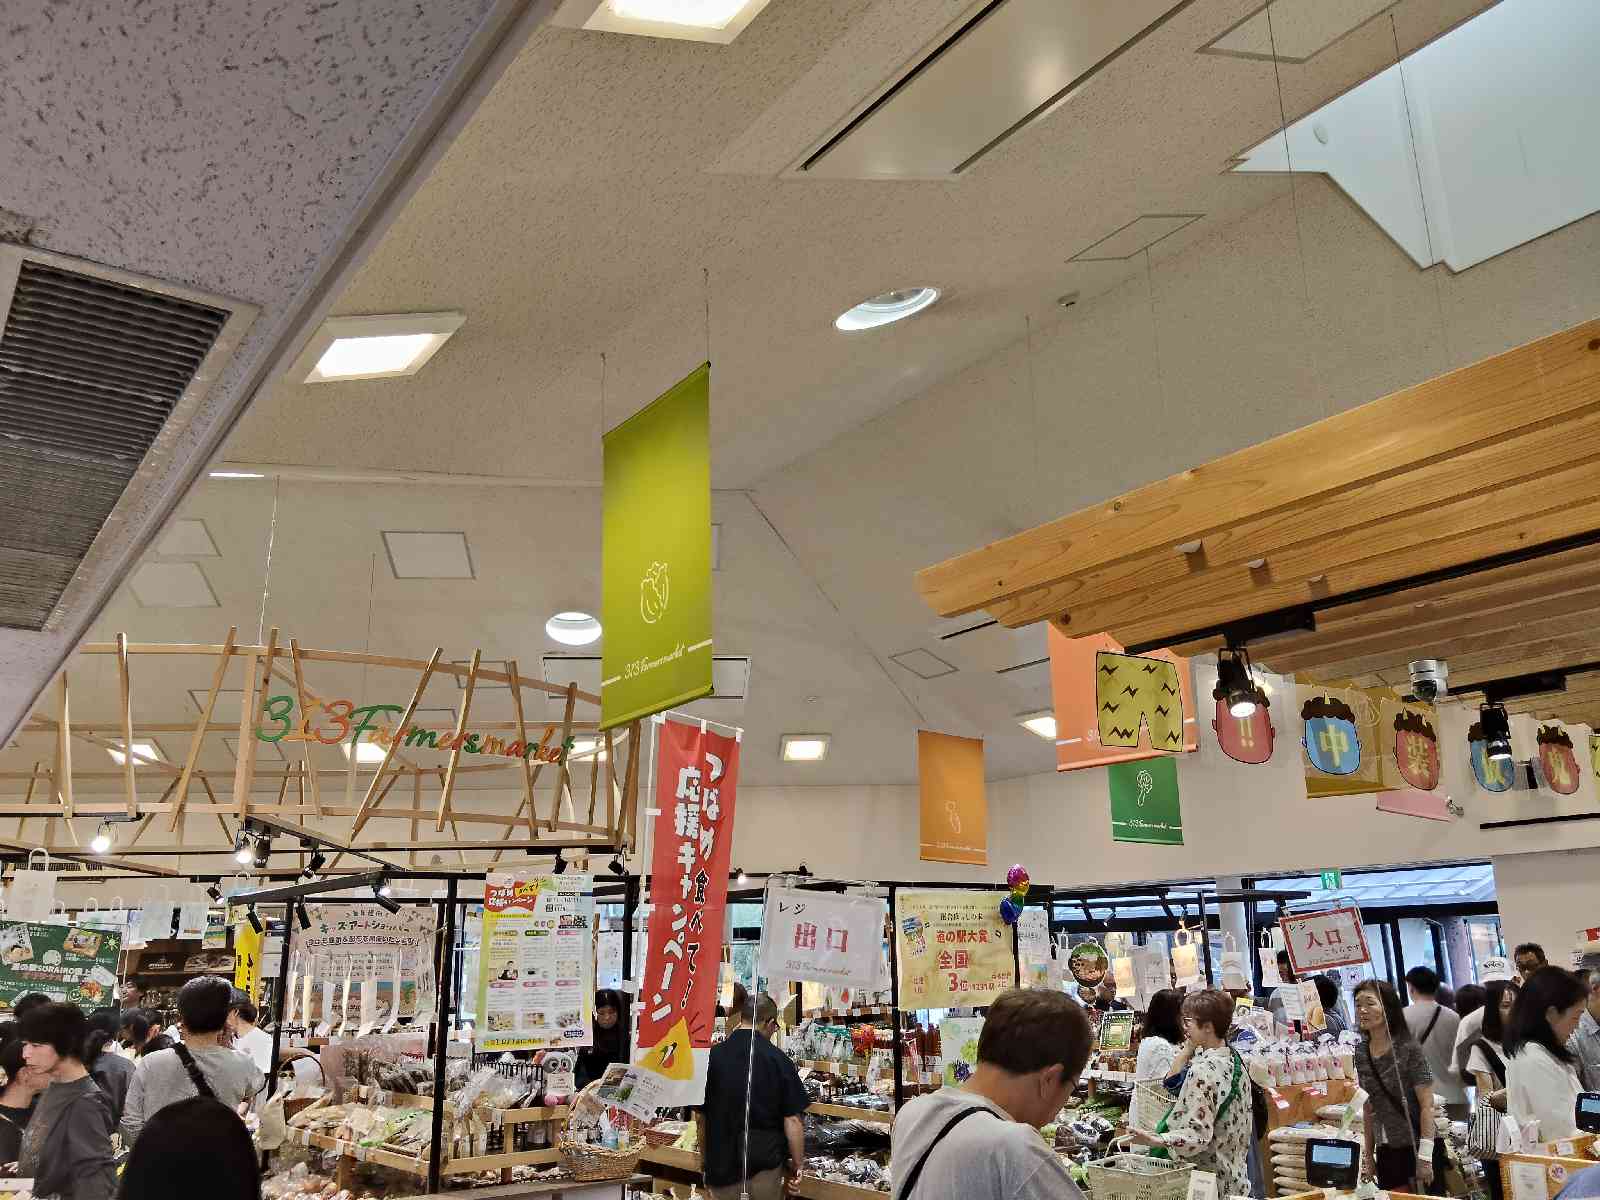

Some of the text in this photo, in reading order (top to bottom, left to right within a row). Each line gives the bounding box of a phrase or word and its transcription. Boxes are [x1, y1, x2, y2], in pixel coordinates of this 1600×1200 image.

[779, 901, 807, 915] レジ
[1289, 921, 1306, 931] レジ
[794, 922, 849, 952] 出口
[936, 929, 990, 944] 道の駅大賞
[1304, 928, 1343, 951] 入口
[938, 949, 970, 970] 全国
